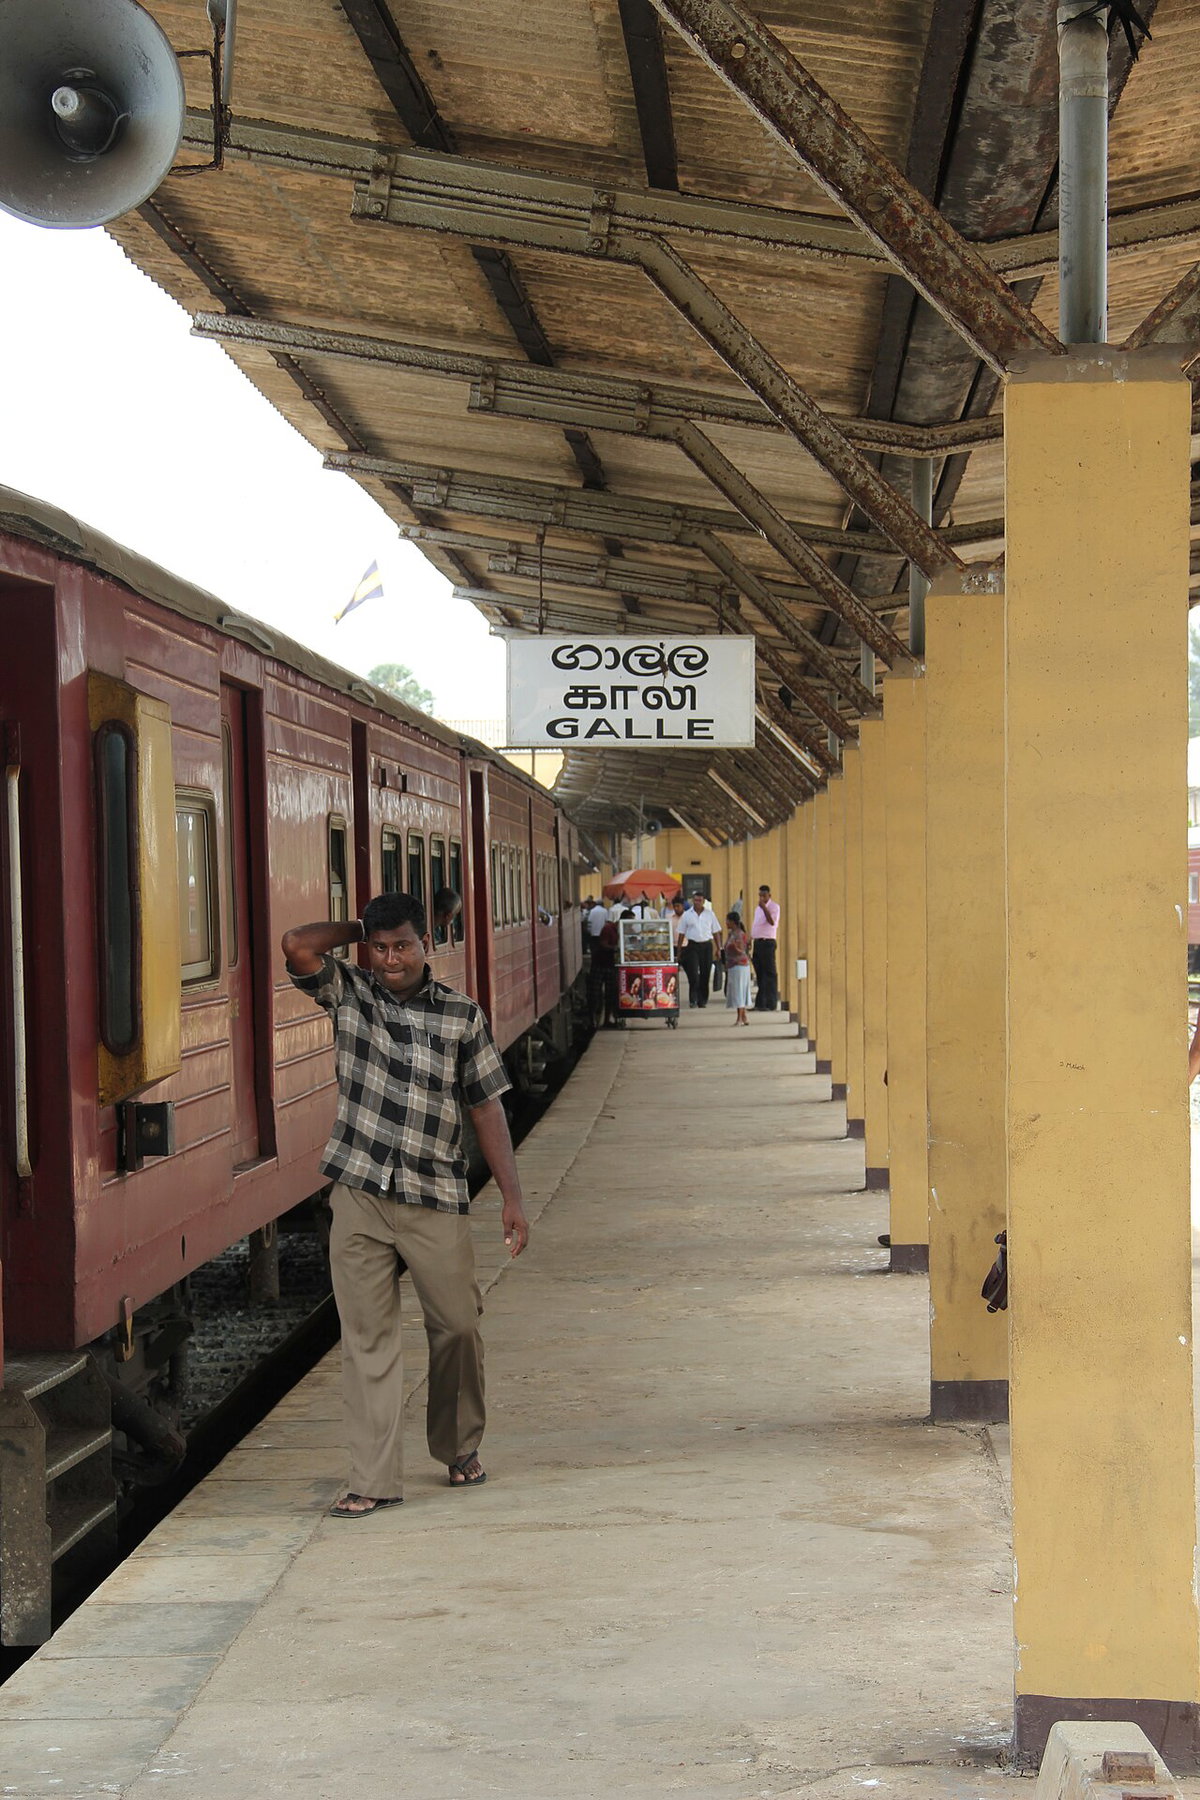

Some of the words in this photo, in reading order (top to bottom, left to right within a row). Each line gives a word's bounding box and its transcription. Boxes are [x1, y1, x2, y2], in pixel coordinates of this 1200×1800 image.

[551, 642, 709, 679] ගාල්ල
[563, 684, 697, 711] காலி
[545, 717, 714, 740] GALLE
